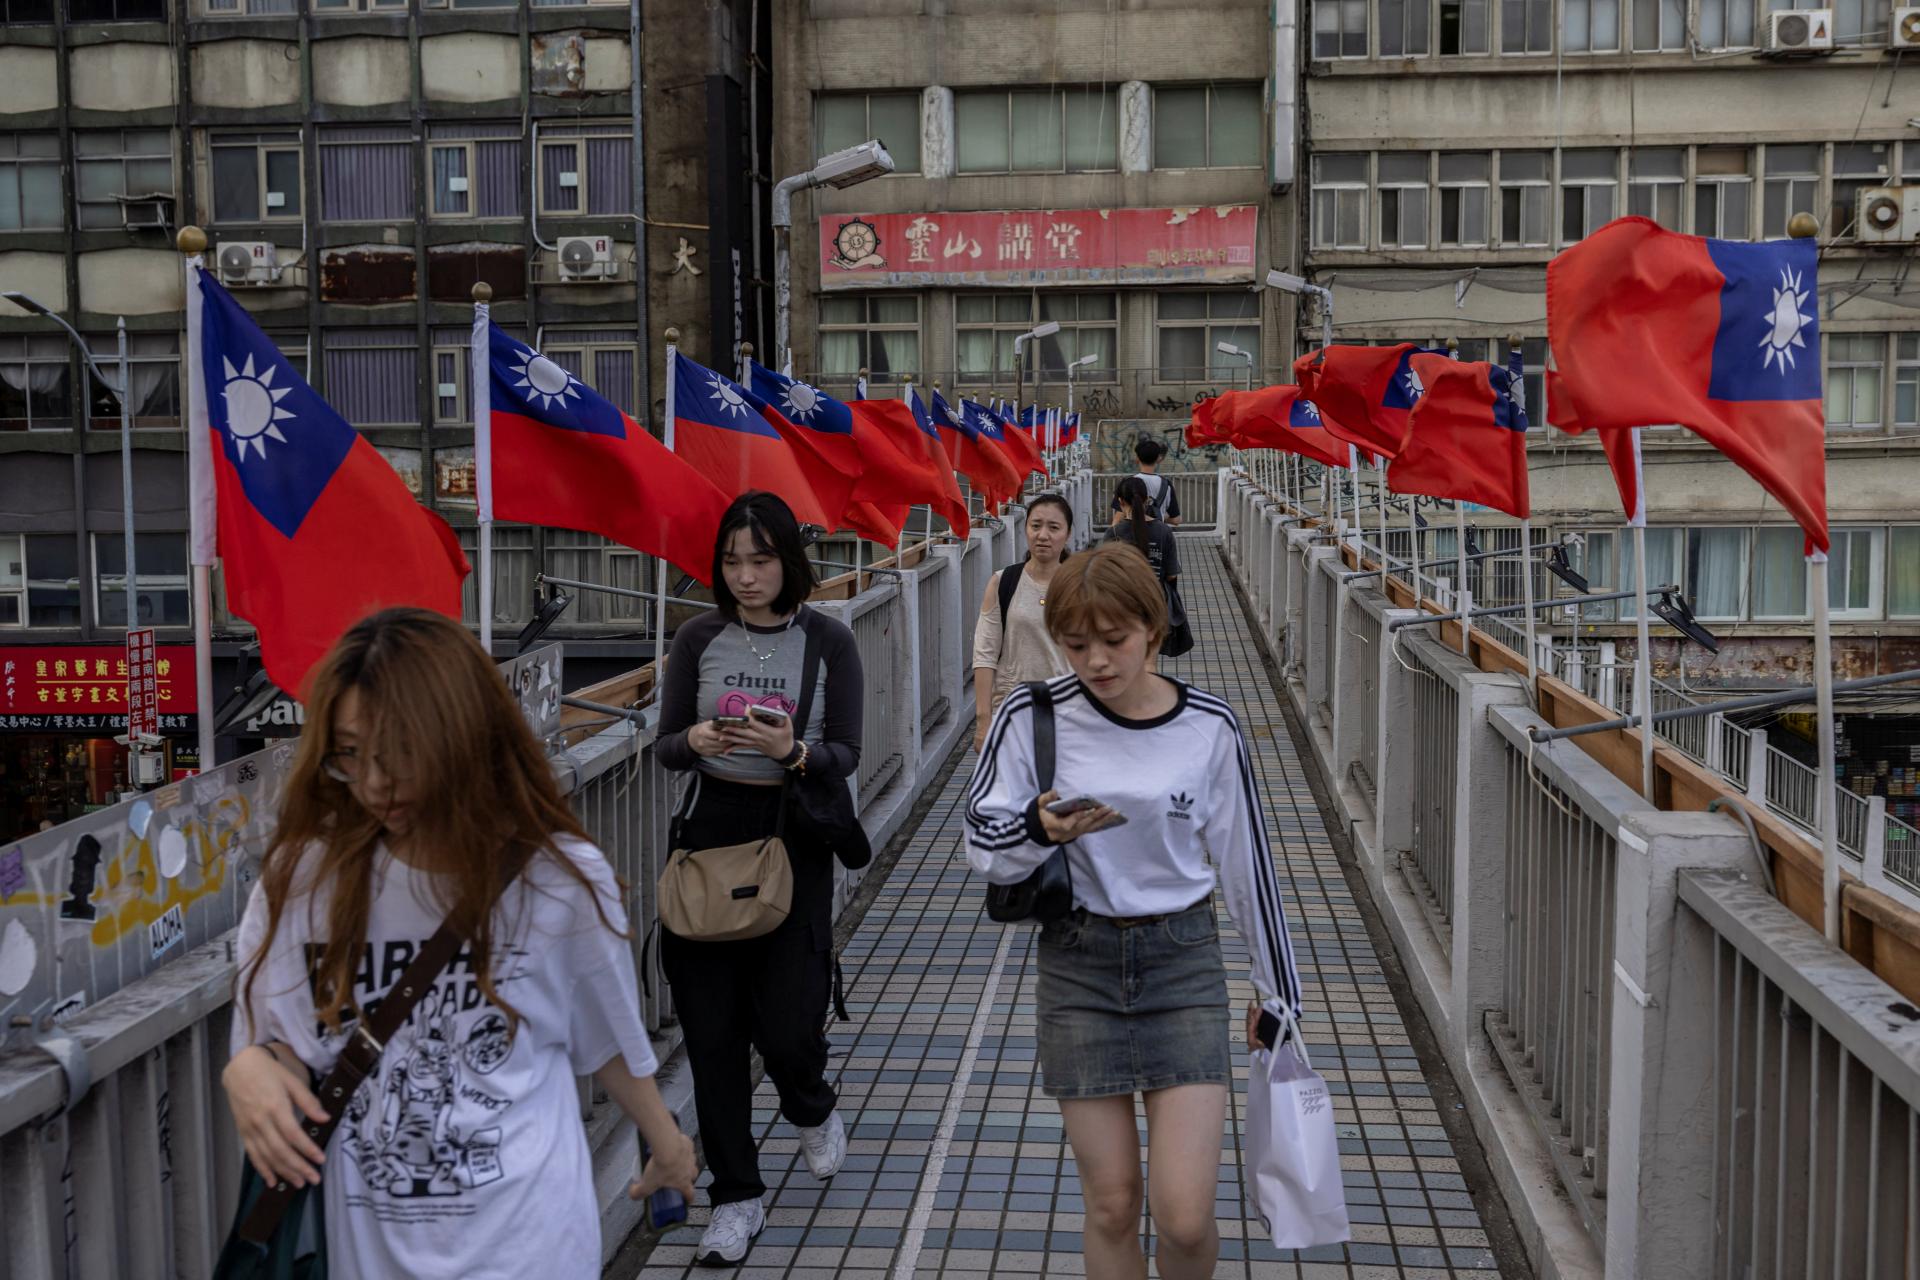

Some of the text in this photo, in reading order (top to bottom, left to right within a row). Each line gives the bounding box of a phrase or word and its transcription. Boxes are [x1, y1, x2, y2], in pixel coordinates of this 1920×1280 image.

[672, 237, 703, 275] 大
[905, 217, 1082, 262] 靈山講堂
[723, 672, 787, 689] chuu
[1166, 811, 1190, 820] adidas
[151, 905, 182, 949] ALOHA
